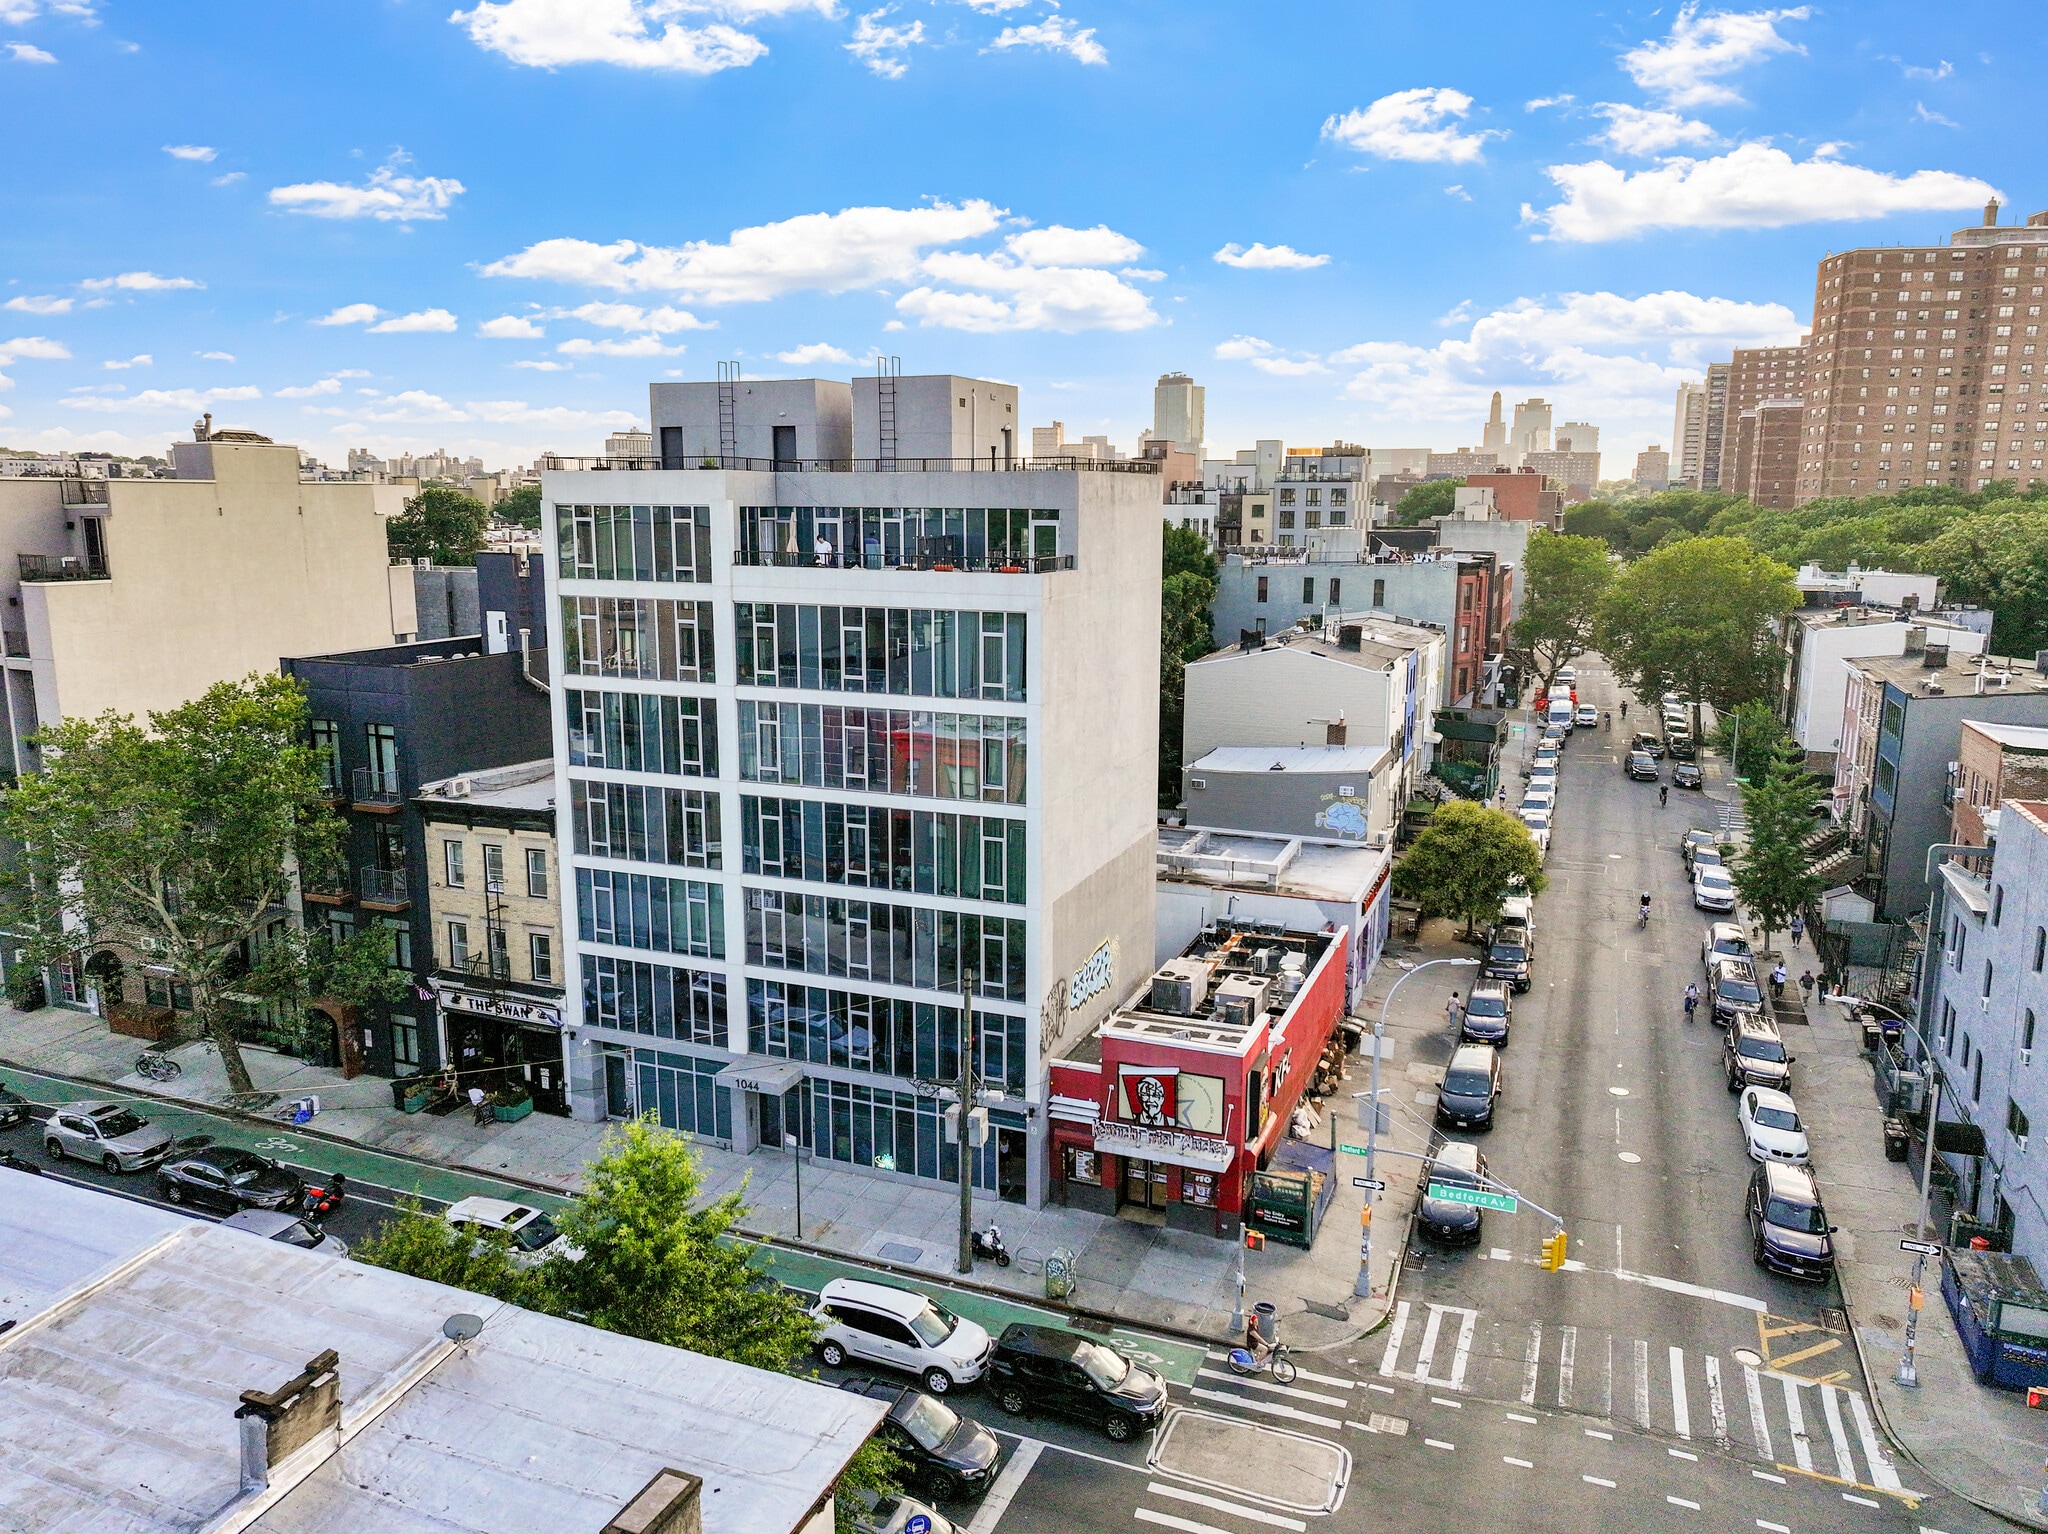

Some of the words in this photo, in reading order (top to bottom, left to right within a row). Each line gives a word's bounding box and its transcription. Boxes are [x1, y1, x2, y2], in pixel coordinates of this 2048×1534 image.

[467, 998, 492, 1012] THE
[495, 1003, 529, 1019] SWAN
[735, 1079, 760, 1091] 1044
[1341, 1145, 1360, 1155] Bedford
[1440, 1189, 1487, 1204] Bedford
[1490, 1197, 1506, 1208] Av
